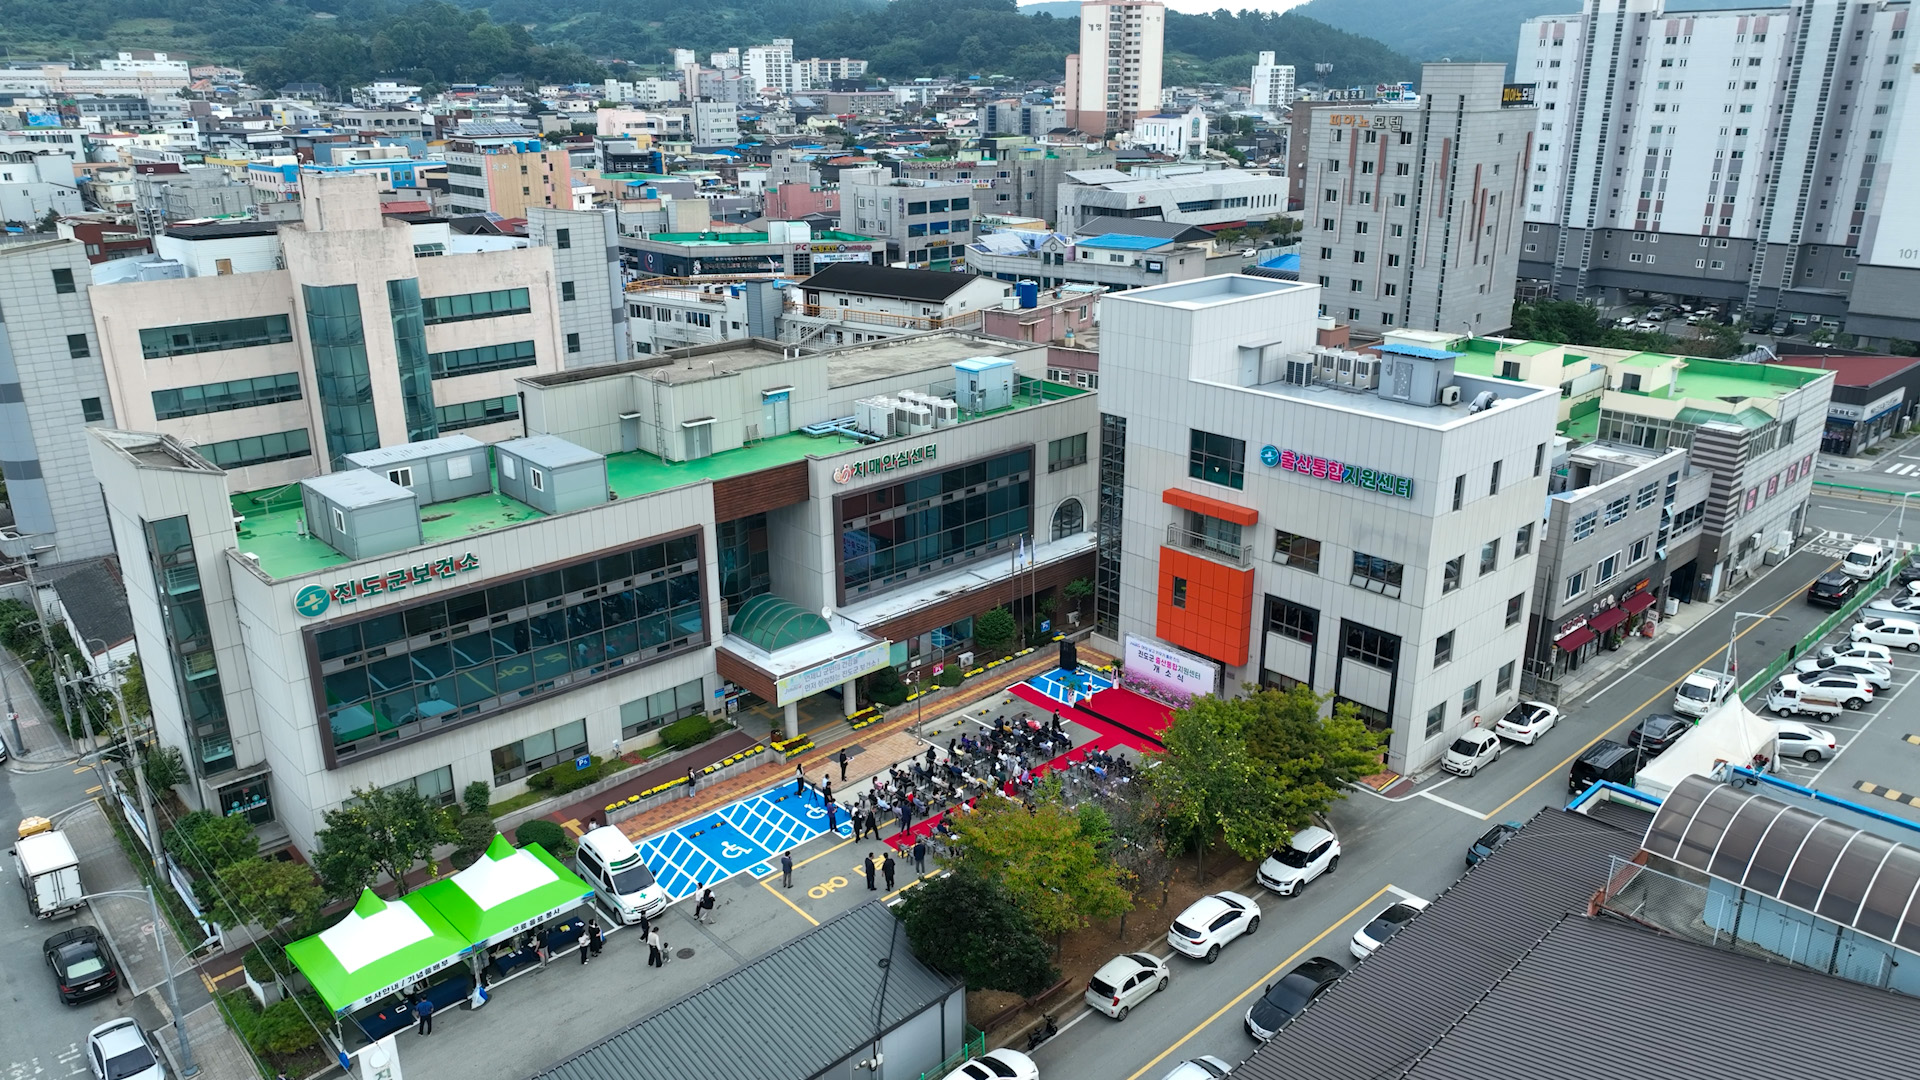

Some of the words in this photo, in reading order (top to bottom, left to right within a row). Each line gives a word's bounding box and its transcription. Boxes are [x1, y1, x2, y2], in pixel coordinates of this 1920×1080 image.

[1899, 248, 1918, 260] 101
[853, 443, 937, 477] 치매안심센터
[1280, 450, 1413, 499] 출산통합지원센터
[334, 552, 480, 605] 진도군보건소
[1138, 650, 1154, 662] 진도군
[512, 923, 527, 934] 무료
[364, 984, 400, 1004] 행사안내
